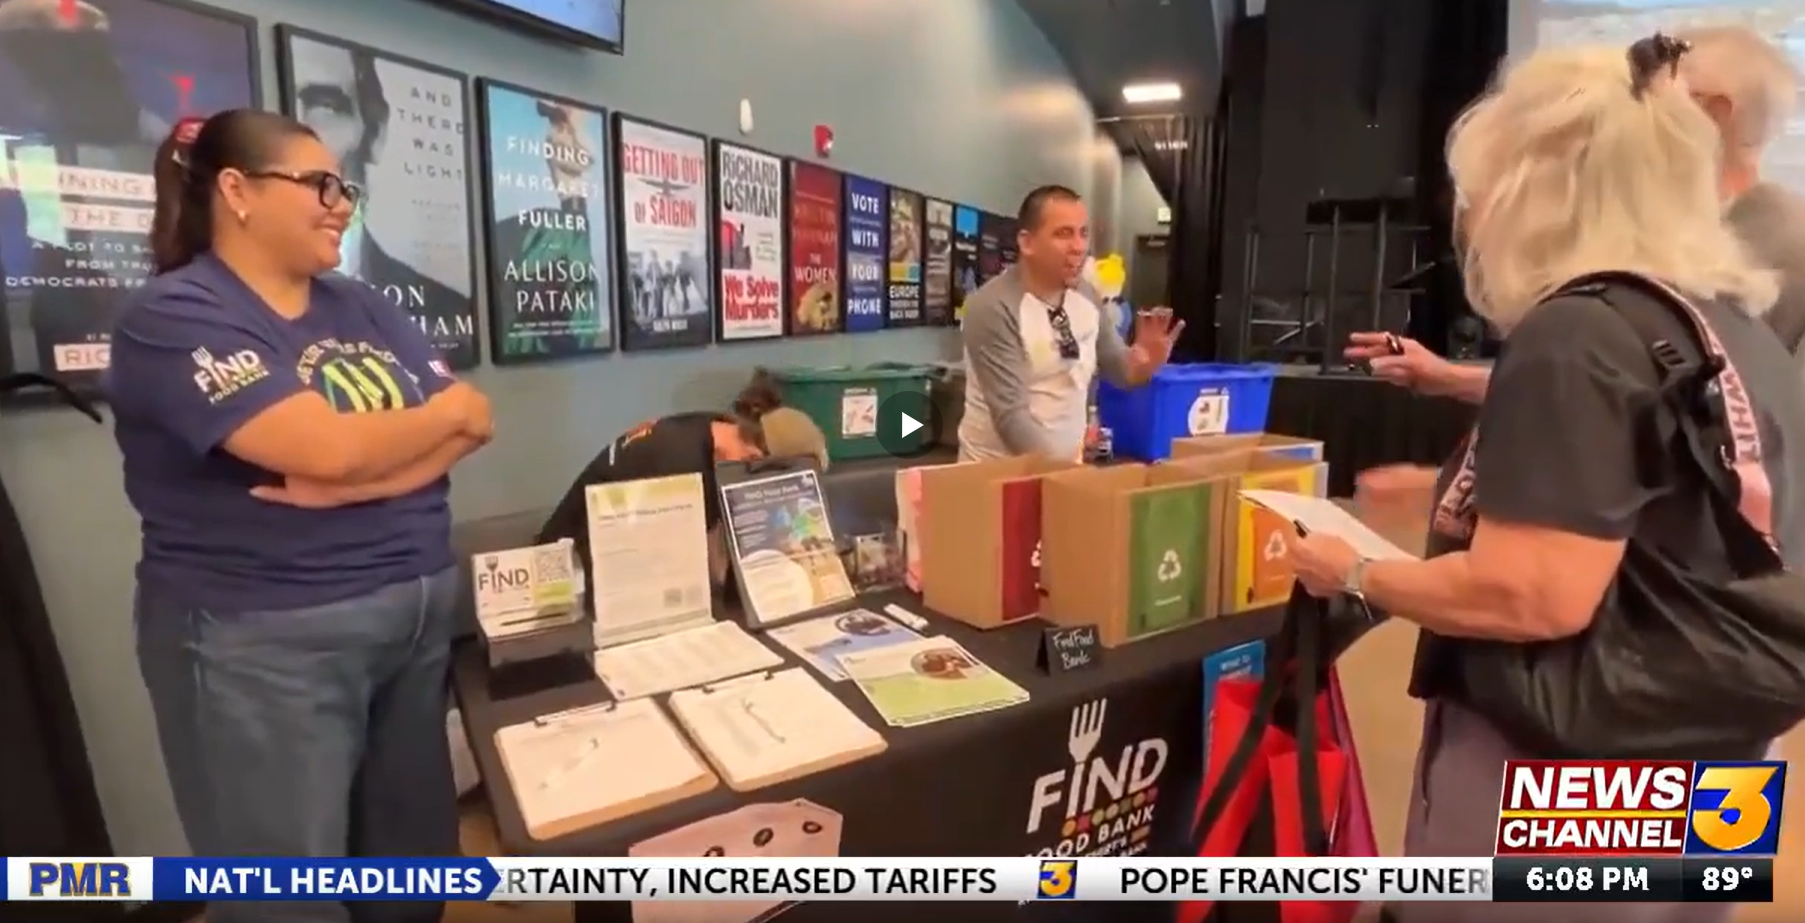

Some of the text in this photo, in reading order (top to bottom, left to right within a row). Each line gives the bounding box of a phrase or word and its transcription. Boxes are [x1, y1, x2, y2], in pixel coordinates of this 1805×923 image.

[411, 87, 451, 107] AND
[412, 139, 454, 156] WAS
[507, 136, 590, 166] FINDING
[623, 142, 705, 187] GETTING OUT
[649, 193, 698, 229] SAIGON
[723, 180, 778, 219] OSMAN
[851, 192, 879, 215] VOTE
[518, 209, 587, 232] FULLER
[852, 229, 879, 248] WITH
[65, 259, 116, 270] FROM
[504, 259, 600, 284] ALLISON
[794, 265, 836, 284] WOMEN
[852, 263, 879, 281] YOUR
[5, 276, 119, 288] DEMOCRATS
[724, 275, 779, 300] We Solve
[516, 290, 595, 314] PATAKI
[725, 298, 779, 321] Murders
[847, 298, 882, 315] PHONE
[193, 347, 260, 393] FIND
[478, 560, 529, 591] FIND
[1026, 712, 1169, 834] FIND
[1023, 832, 1090, 857] OOD
[1097, 804, 1154, 844] BANK
